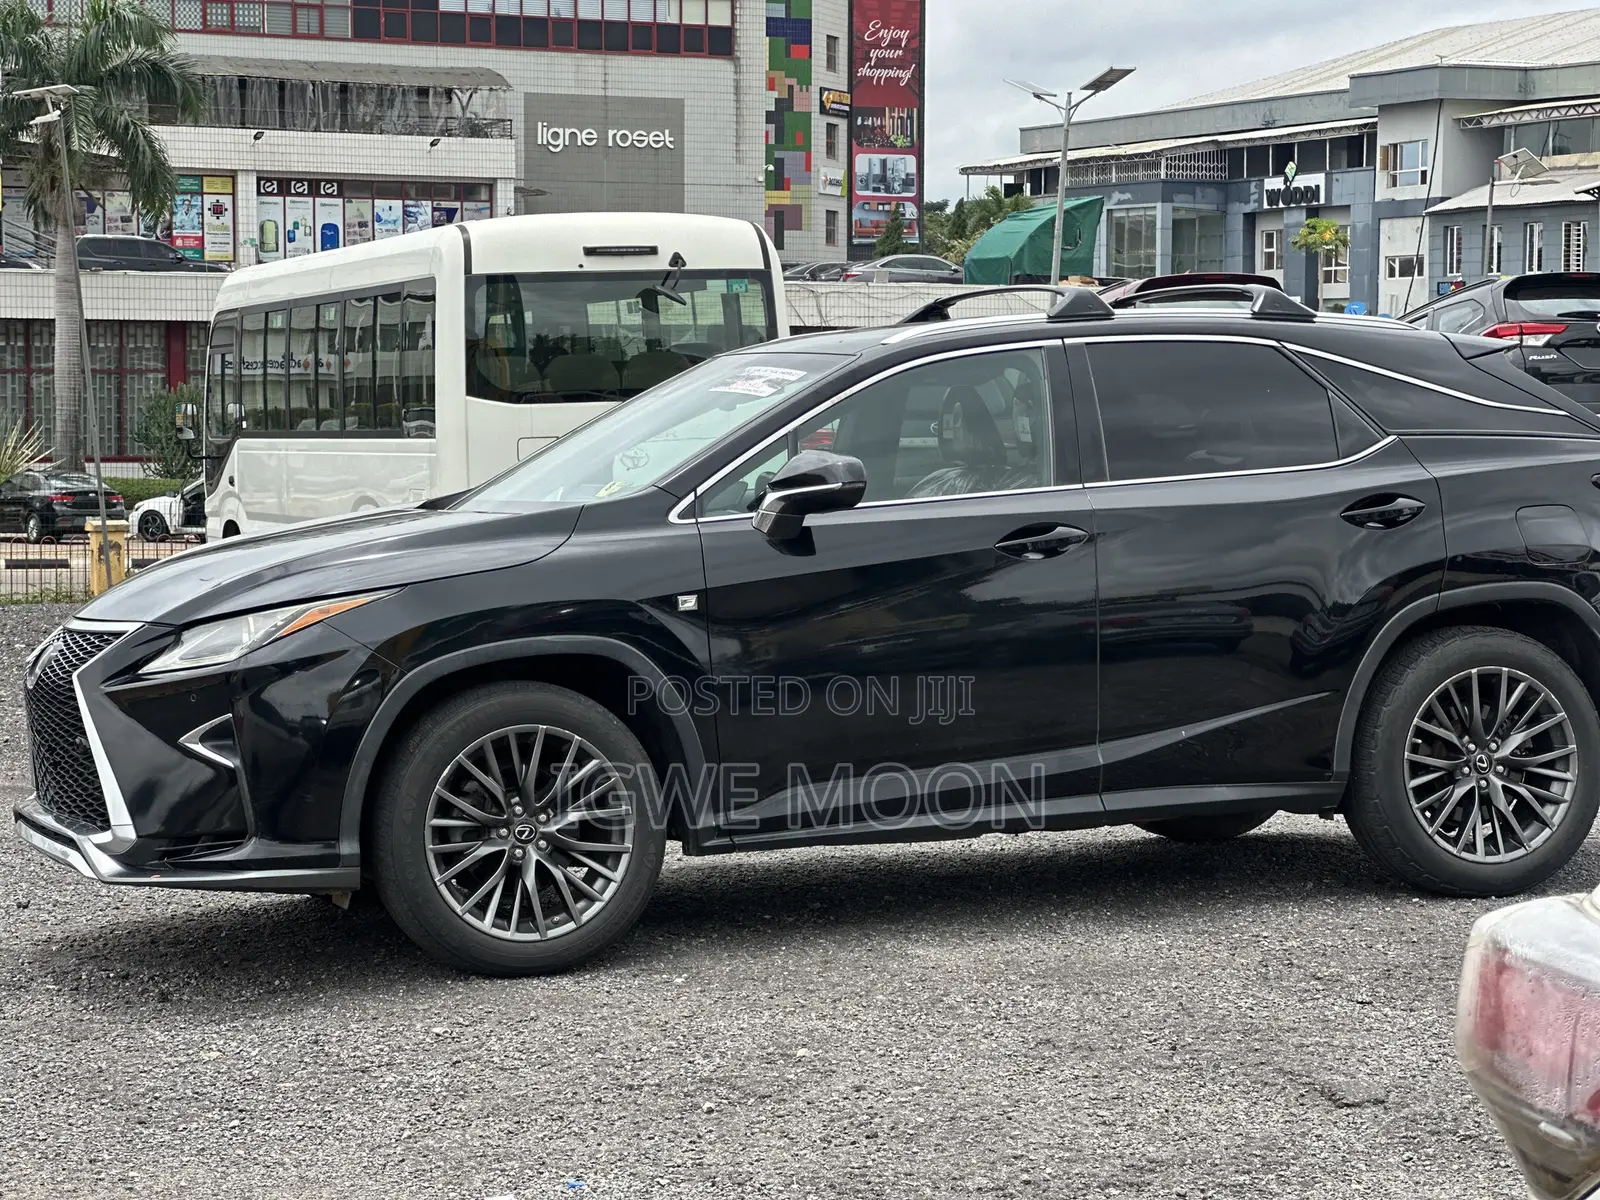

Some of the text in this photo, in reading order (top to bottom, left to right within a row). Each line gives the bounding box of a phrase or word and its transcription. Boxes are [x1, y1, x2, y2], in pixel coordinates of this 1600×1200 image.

[864, 20, 910, 47] Enjoy
[869, 47, 903, 65] your
[856, 62, 915, 86] shopping!
[537, 121, 674, 152] ligne roset
[1265, 184, 1320, 207] WODDI
